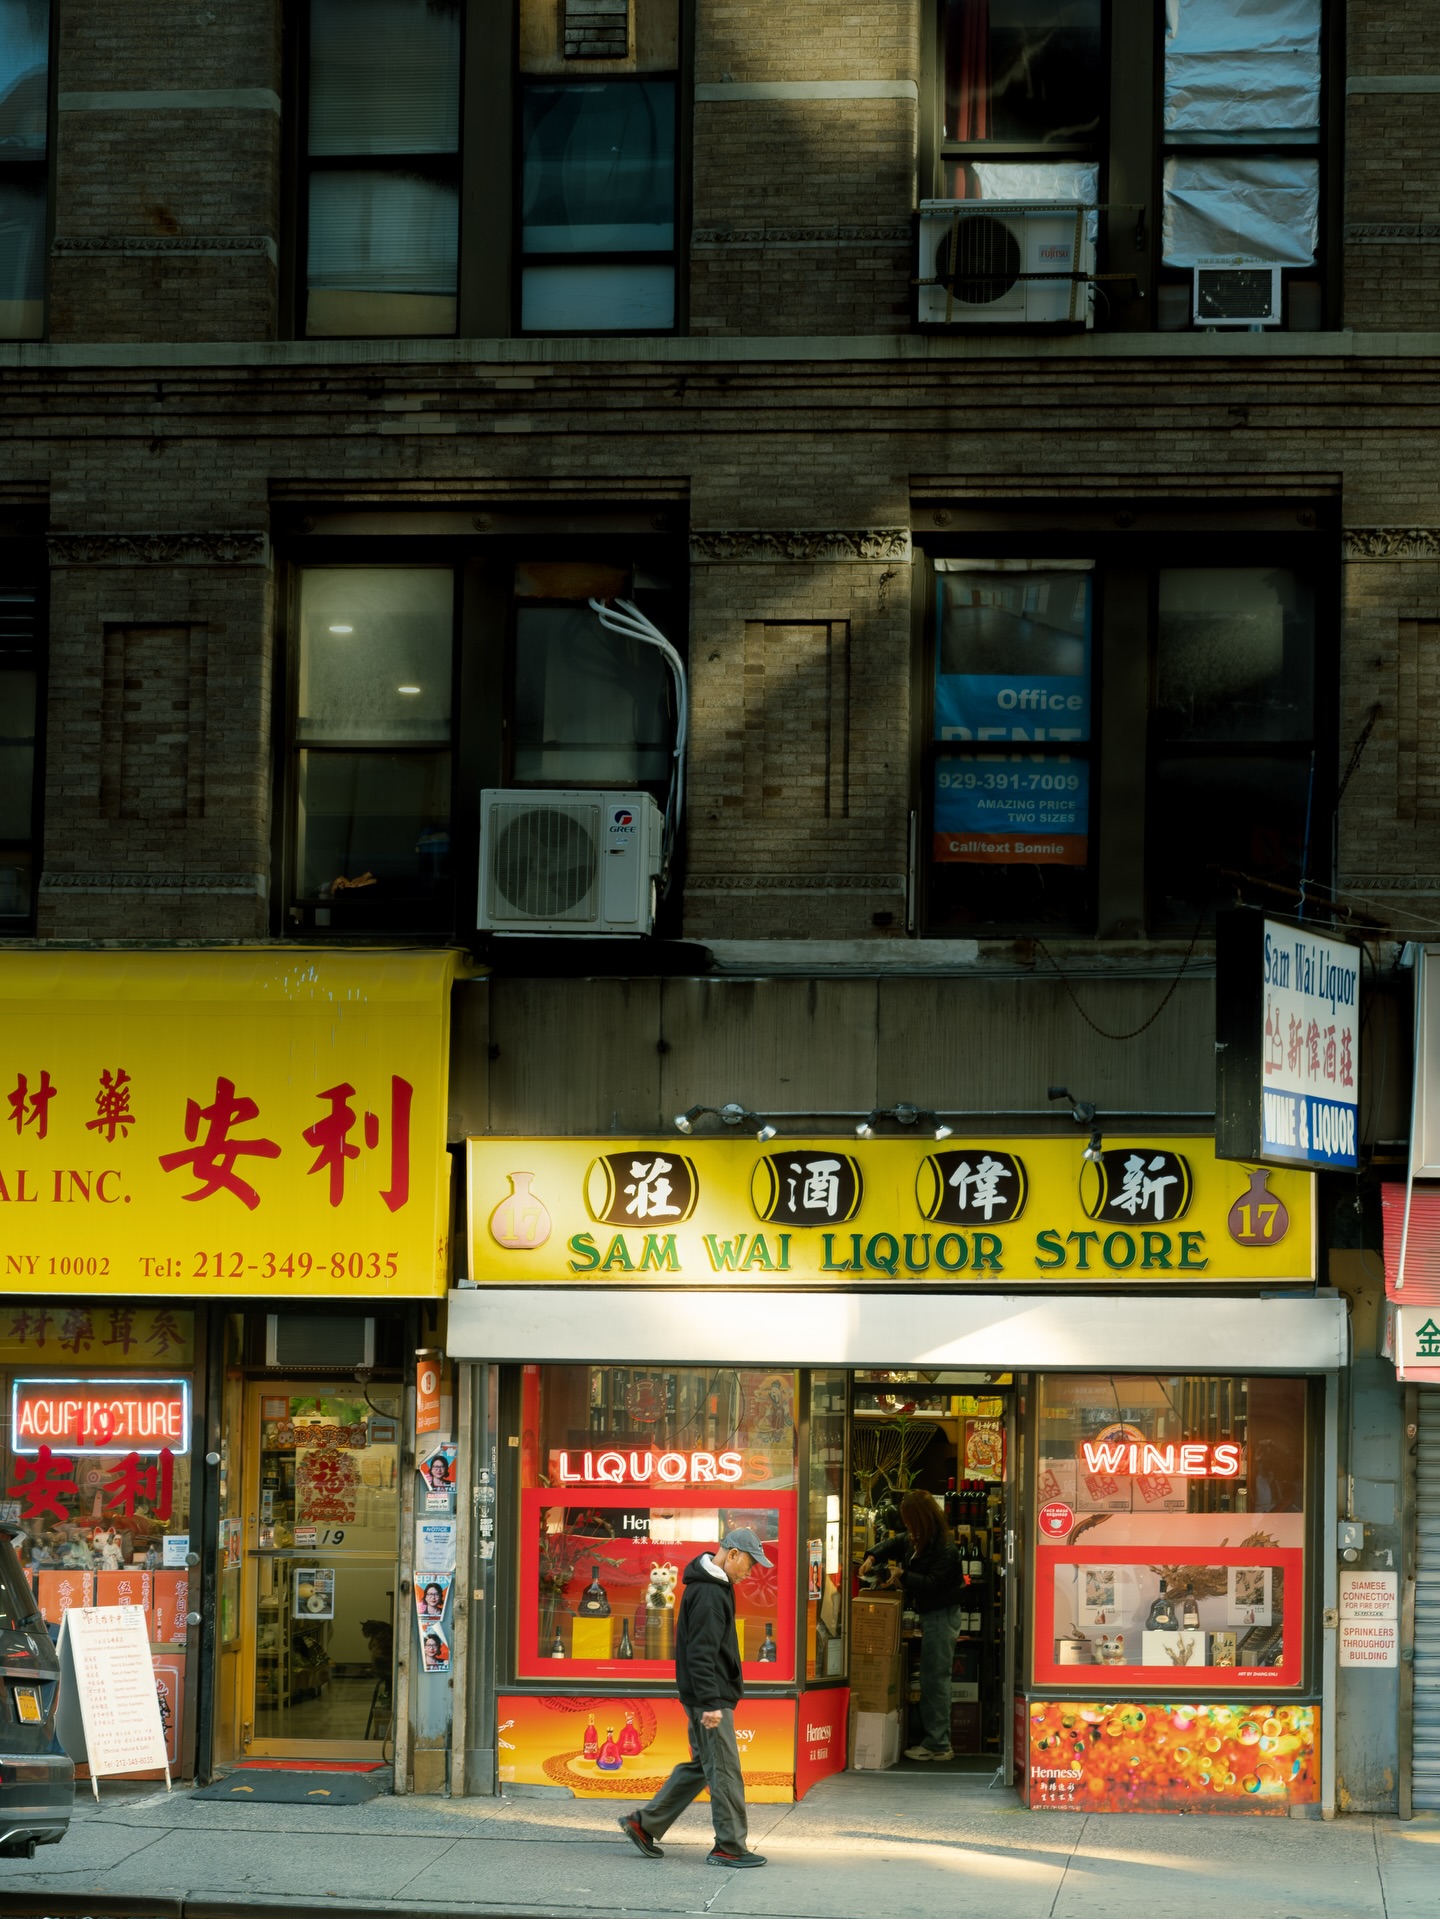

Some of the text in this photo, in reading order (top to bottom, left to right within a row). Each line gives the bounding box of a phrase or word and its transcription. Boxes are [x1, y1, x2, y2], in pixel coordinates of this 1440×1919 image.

[1041, 248, 1069, 259] FUJITSU
[996, 688, 1083, 711] Office
[938, 773, 1079, 790] 929-391-7009
[977, 799, 1076, 811] AMAZING PRICE
[1008, 813, 1075, 823] TWO SIZES
[949, 840, 1064, 854] Call/text Bonnie
[1264, 933, 1357, 1015] Sam Wai Liquor
[1263, 1092, 1356, 1158] WINE & LIQUOR
[51, 1169, 132, 1204] INC.
[500, 1206, 542, 1242] 17
[1236, 1202, 1280, 1239] 17
[569, 1228, 1210, 1277] SAM WAI LIQUOR STORE
[5, 1250, 399, 1279] NY 10002 Tel: 212-349-8035
[19, 1399, 182, 1436] ACUPUNCTURE
[559, 1451, 743, 1484] LIQUORS
[1082, 1442, 1240, 1477] WINES
[322, 1529, 345, 1546] 19
[1351, 1581, 1387, 1590] SIAMESE
[1342, 1592, 1395, 1601] CONNECTION
[1343, 1628, 1394, 1637] SPRINKLERS
[1342, 1639, 1395, 1648] THROUGHOUT
[1349, 1652, 1388, 1660] BUILDING
[807, 1723, 832, 1743] Hennessy
[1030, 1765, 1084, 1780] Hennessy
